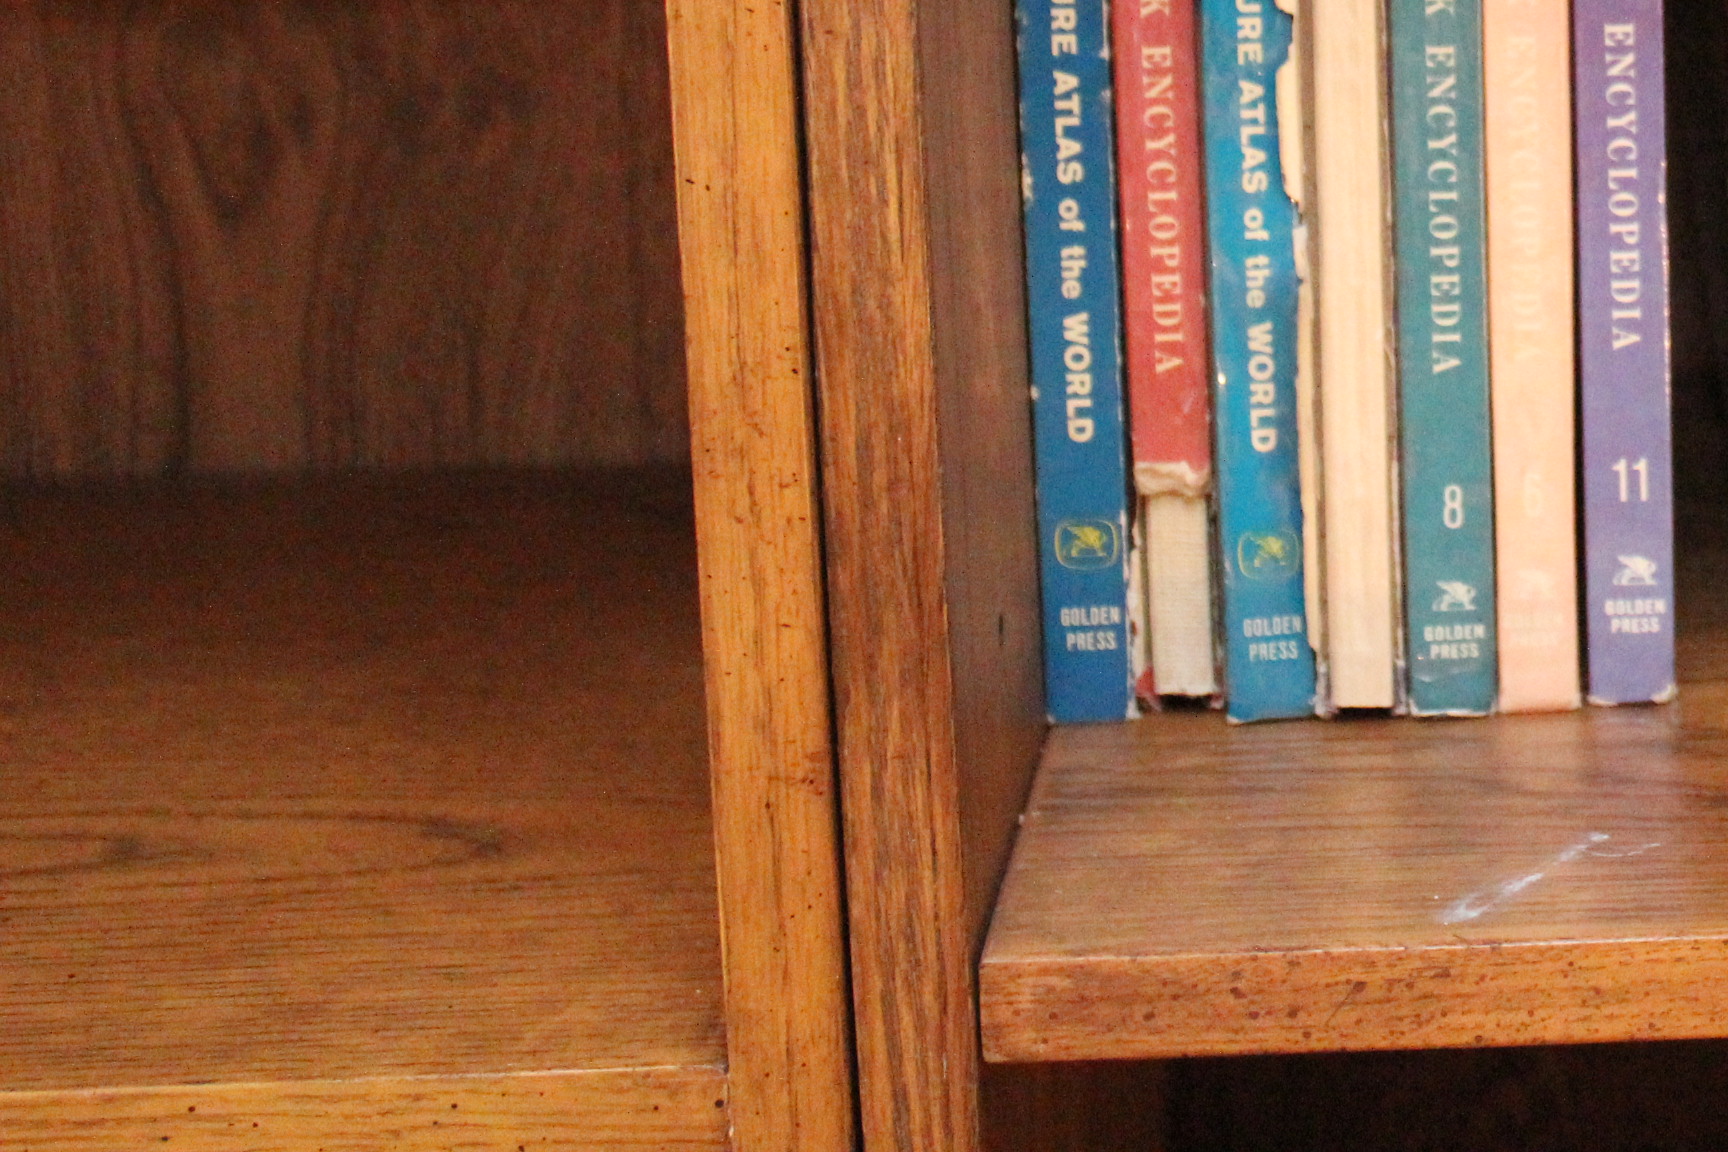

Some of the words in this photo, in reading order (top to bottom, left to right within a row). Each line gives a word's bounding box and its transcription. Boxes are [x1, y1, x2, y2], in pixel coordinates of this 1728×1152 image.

[1052, 71, 1085, 185] ATLAS
[1238, 80, 1268, 194] ATLAS
[1604, 23, 1642, 351] ENCYCLOPEDIA
[1058, 198, 1085, 233] of
[1141, 45, 1185, 375] ENCYCLOPEDIA
[1243, 207, 1270, 242] of
[1425, 45, 1462, 375] ENCYCLOPEDIA
[1060, 246, 1087, 299] the
[1244, 255, 1272, 309] the
[1062, 312, 1095, 443] WORLD
[1246, 321, 1278, 453] WORLD
[1612, 458, 1649, 503] 11
[1443, 484, 1465, 529] 8
[1060, 605, 1122, 627] GOLDEN
[1243, 615, 1302, 638] GOLDEN
[1605, 599, 1666, 616] GOLDEN
[1611, 616, 1661, 634] PRESS
[1066, 631, 1118, 652] PRESS
[1249, 640, 1299, 662] PRESS
[1423, 624, 1485, 642] GOLDEN
[1429, 642, 1480, 660] PRESS
